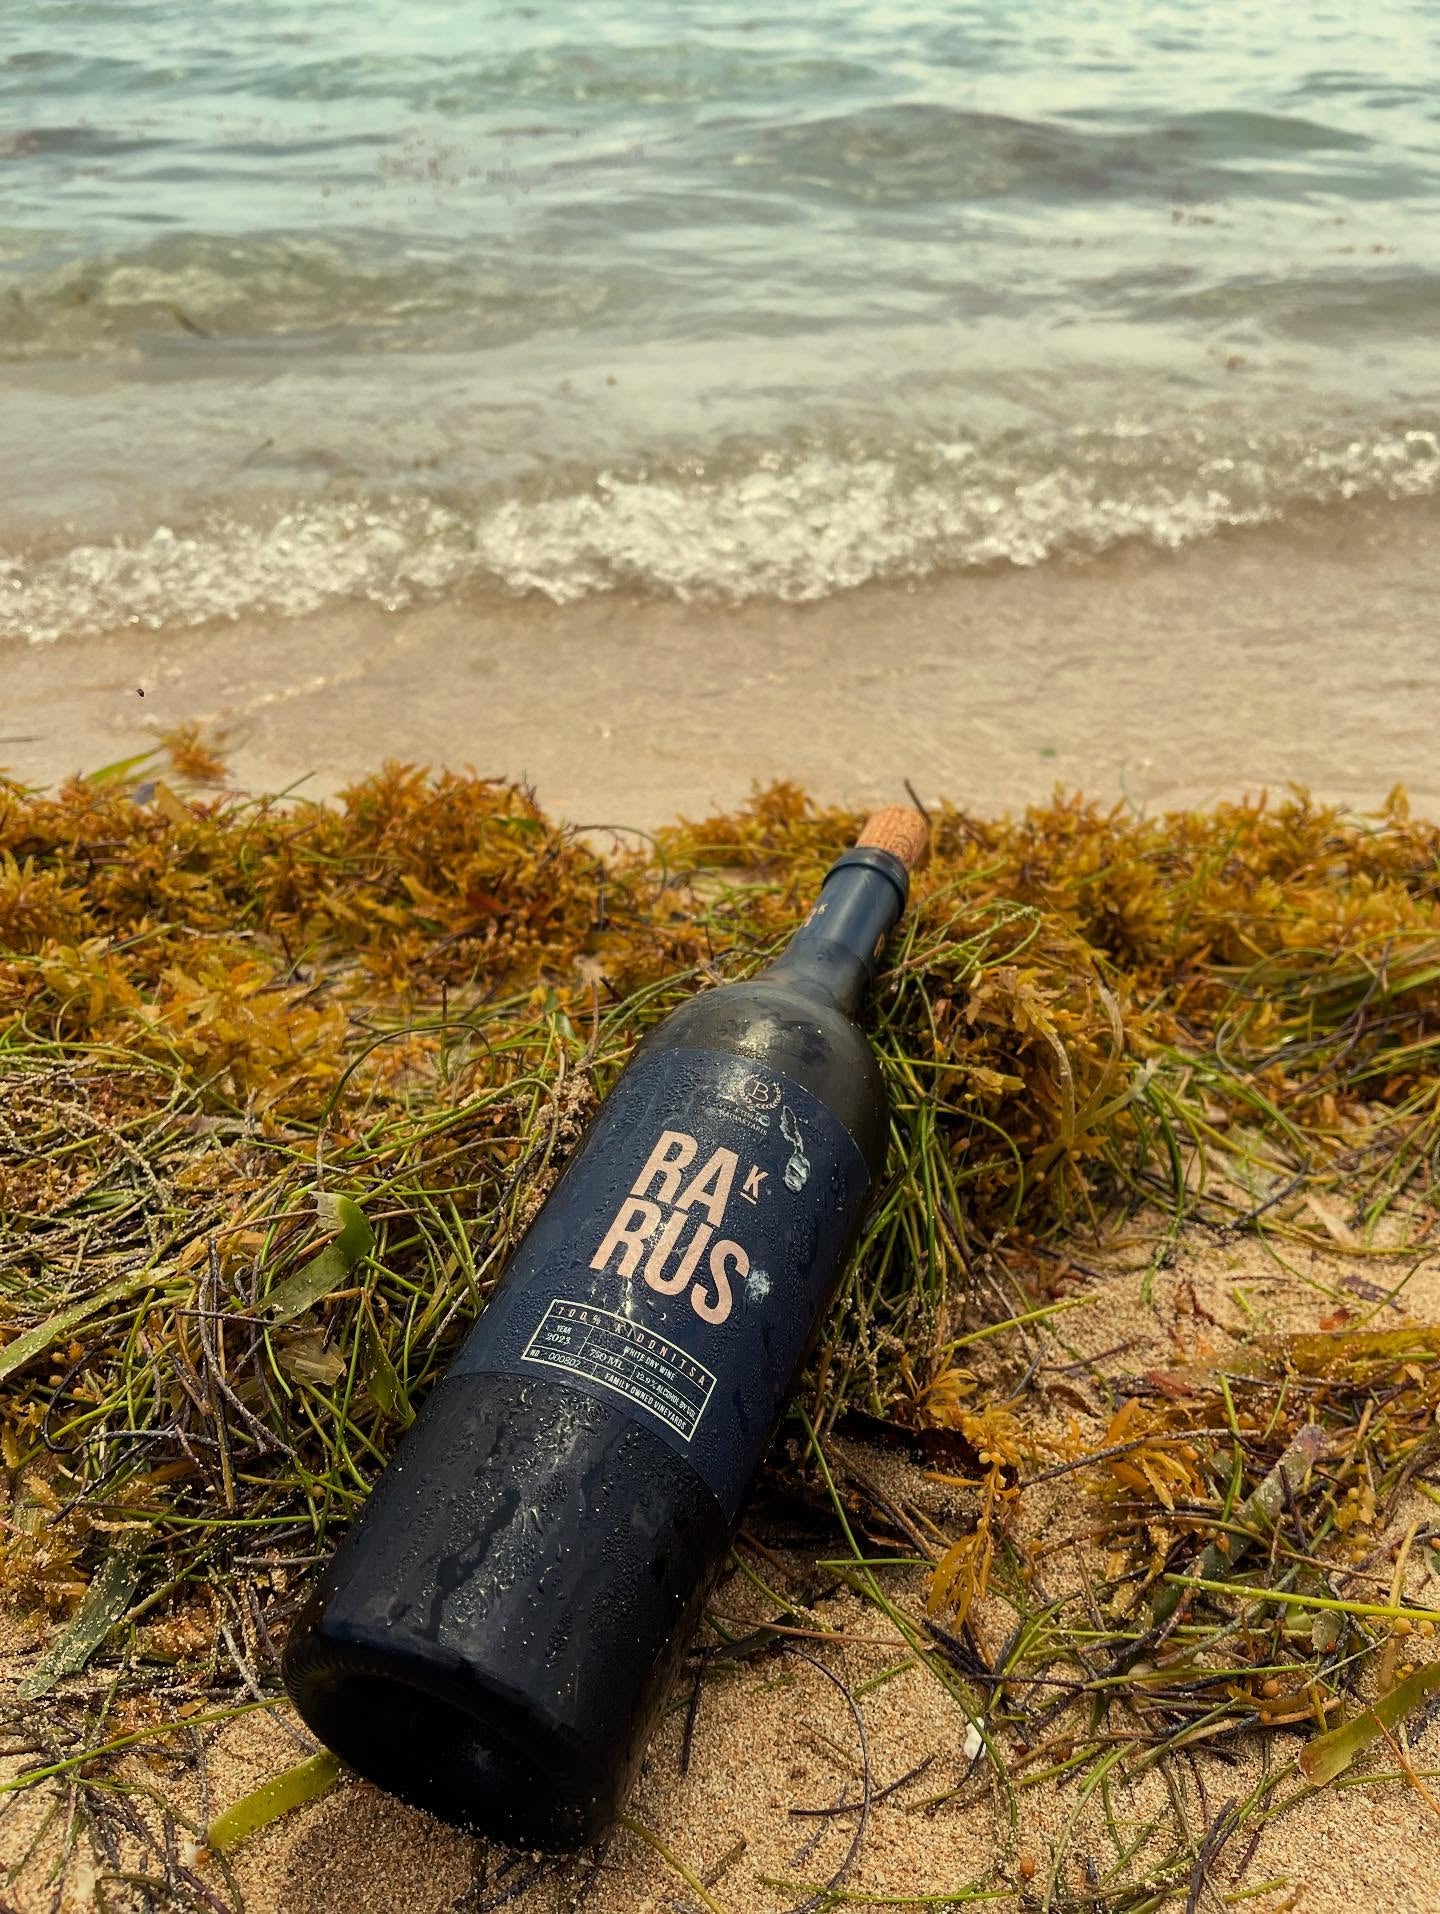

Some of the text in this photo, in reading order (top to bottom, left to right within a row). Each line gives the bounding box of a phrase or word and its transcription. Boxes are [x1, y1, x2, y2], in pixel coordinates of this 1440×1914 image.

[629, 1130, 740, 1228] RA
[589, 1197, 750, 1325] RUS
[545, 1332, 571, 1345] 2023
[556, 1324, 572, 1334] YEAR
[558, 1306, 705, 1386] 100% KIDONITSA
[548, 1352, 581, 1369] 000802
[623, 1345, 677, 1381] WHITE DRY WINE
[604, 1372, 687, 1430] FAMILY OWNED VINEYARDS
[655, 1384, 679, 1405] ALCOHOL
[679, 1400, 688, 1411] BY
